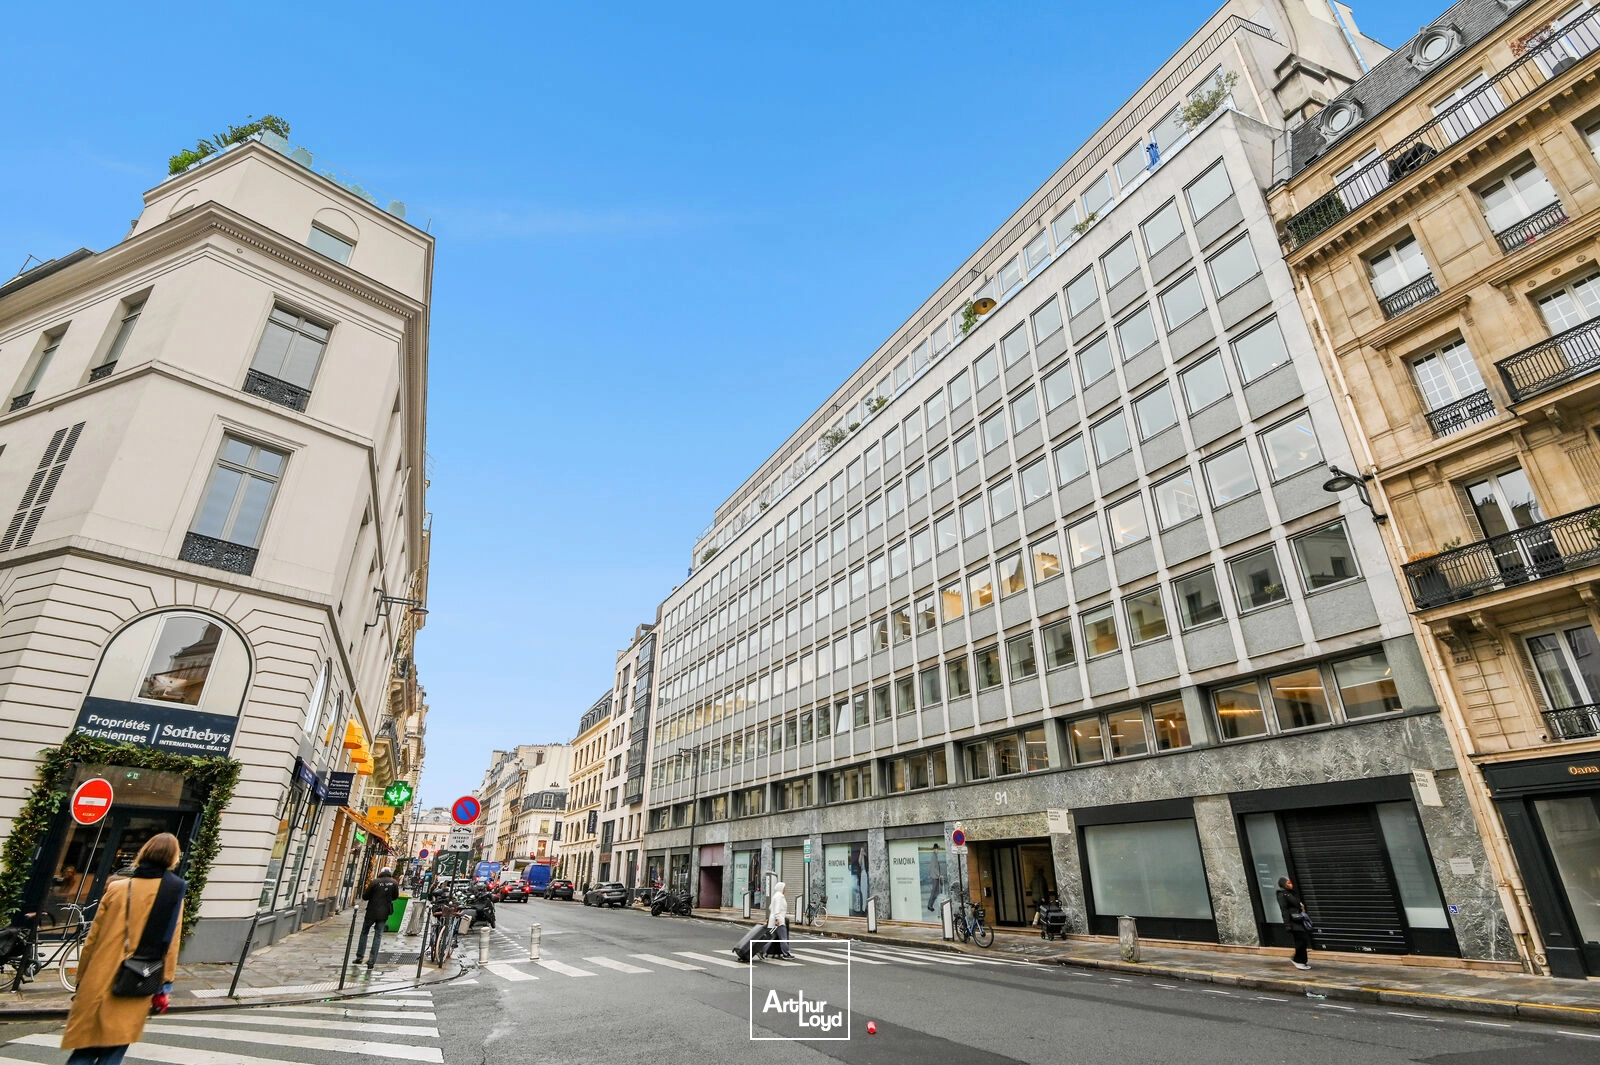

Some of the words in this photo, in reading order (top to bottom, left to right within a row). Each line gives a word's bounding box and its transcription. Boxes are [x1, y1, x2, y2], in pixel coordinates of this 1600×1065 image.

[87, 714, 150, 731] Propriétés
[76, 726, 146, 743] Parisiennes
[162, 724, 230, 744] Sotheby's
[159, 739, 205, 750] INTERNATIONAL
[206, 744, 228, 752] REALTY
[1569, 766, 1599, 775] Oana
[995, 791, 1008, 805] 91
[828, 859, 845, 867] RIMOWA
[893, 857, 915, 866] RIMOWA
